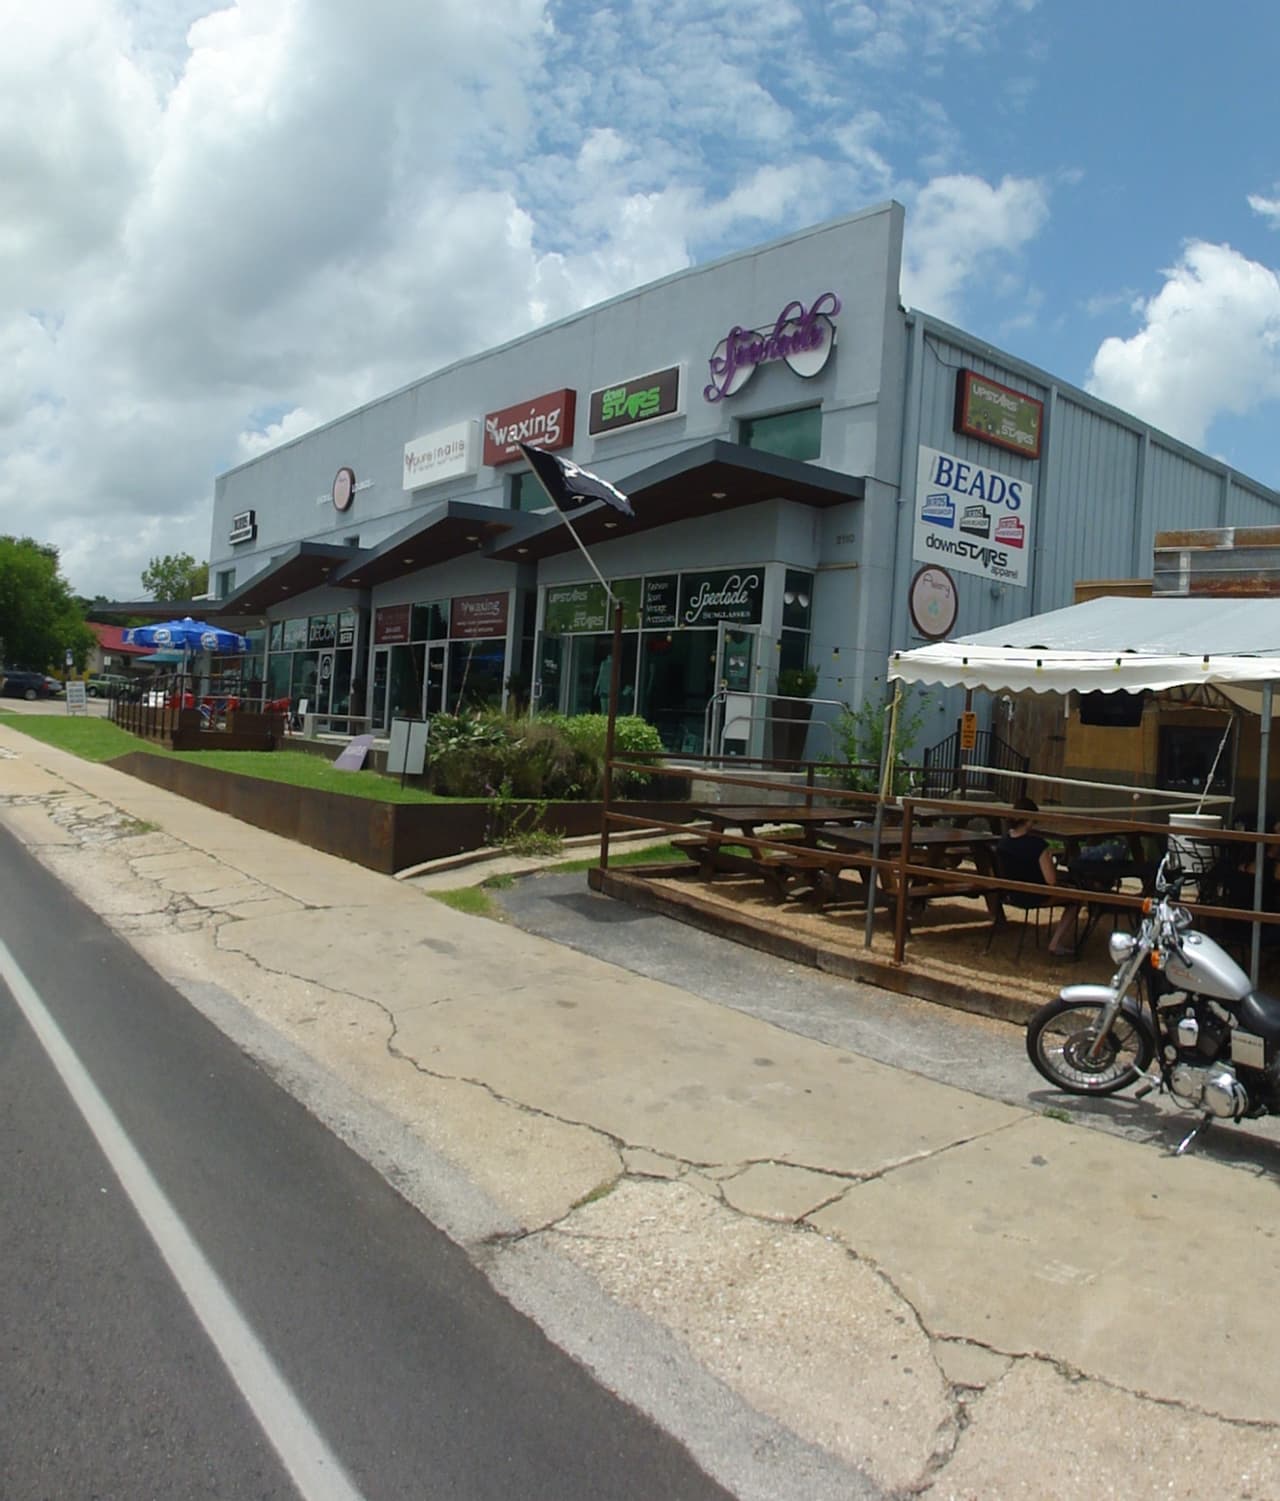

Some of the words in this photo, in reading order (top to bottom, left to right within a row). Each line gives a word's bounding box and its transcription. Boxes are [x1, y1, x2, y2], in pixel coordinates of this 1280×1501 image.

[493, 408, 561, 446] waxing
[934, 456, 1022, 511] BEADS
[685, 574, 759, 623] Spectacle
